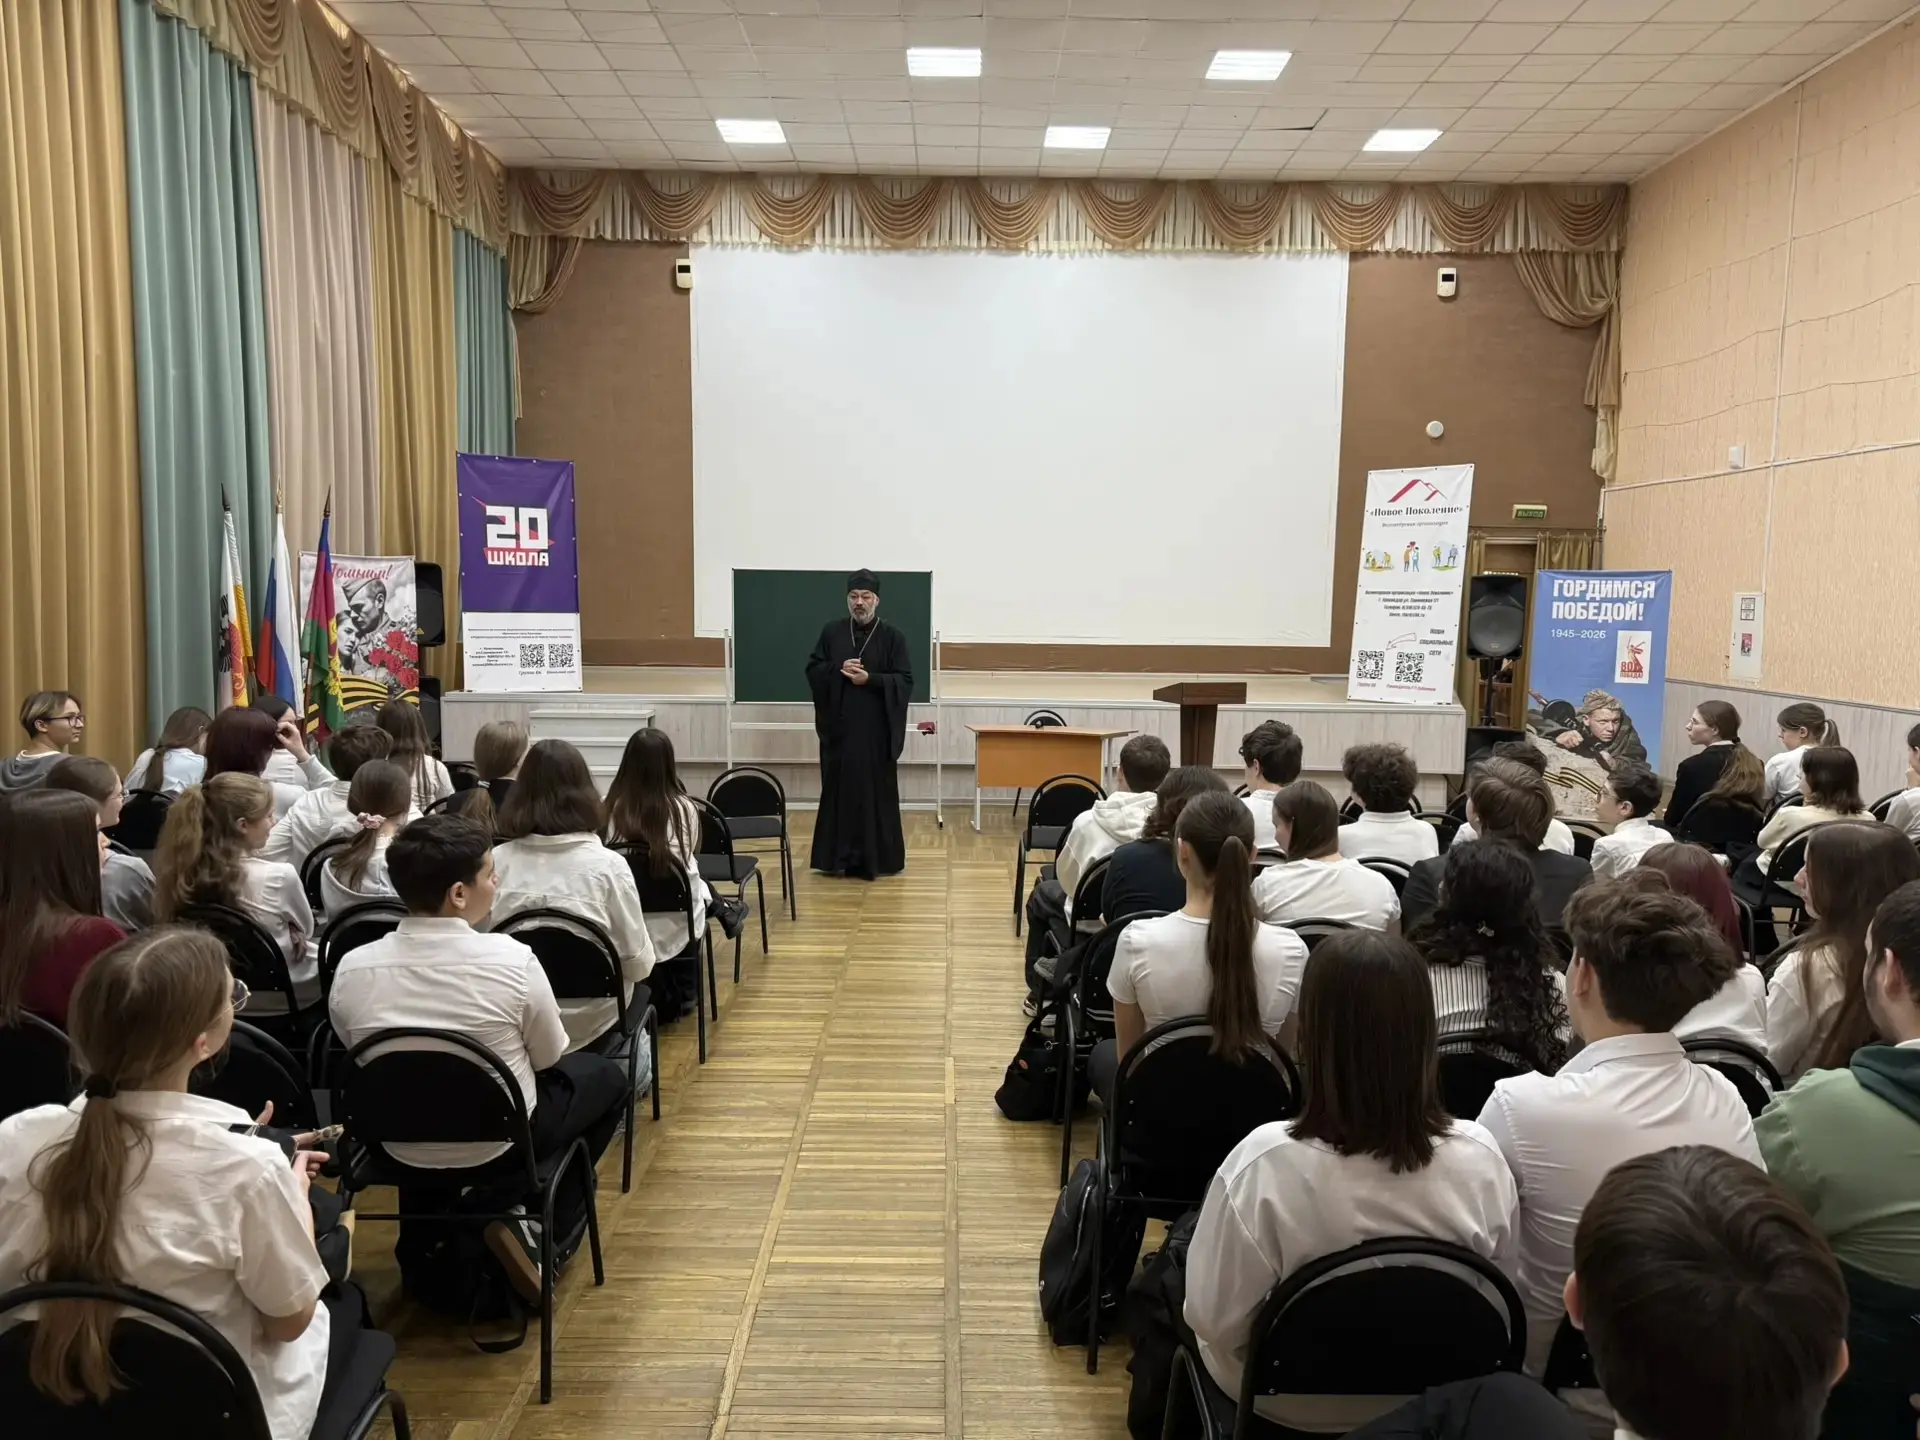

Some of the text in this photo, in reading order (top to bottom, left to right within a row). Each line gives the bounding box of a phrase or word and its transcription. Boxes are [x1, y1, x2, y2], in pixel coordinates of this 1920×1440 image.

[1517, 510, 1544, 518] ВЫХОД
[486, 505, 549, 550] 20
[487, 551, 550, 567] ШКОЛА
[1552, 579, 1656, 601] ГОРДИМСЯ
[1551, 601, 1645, 623] ПОБЕДОЙ!
